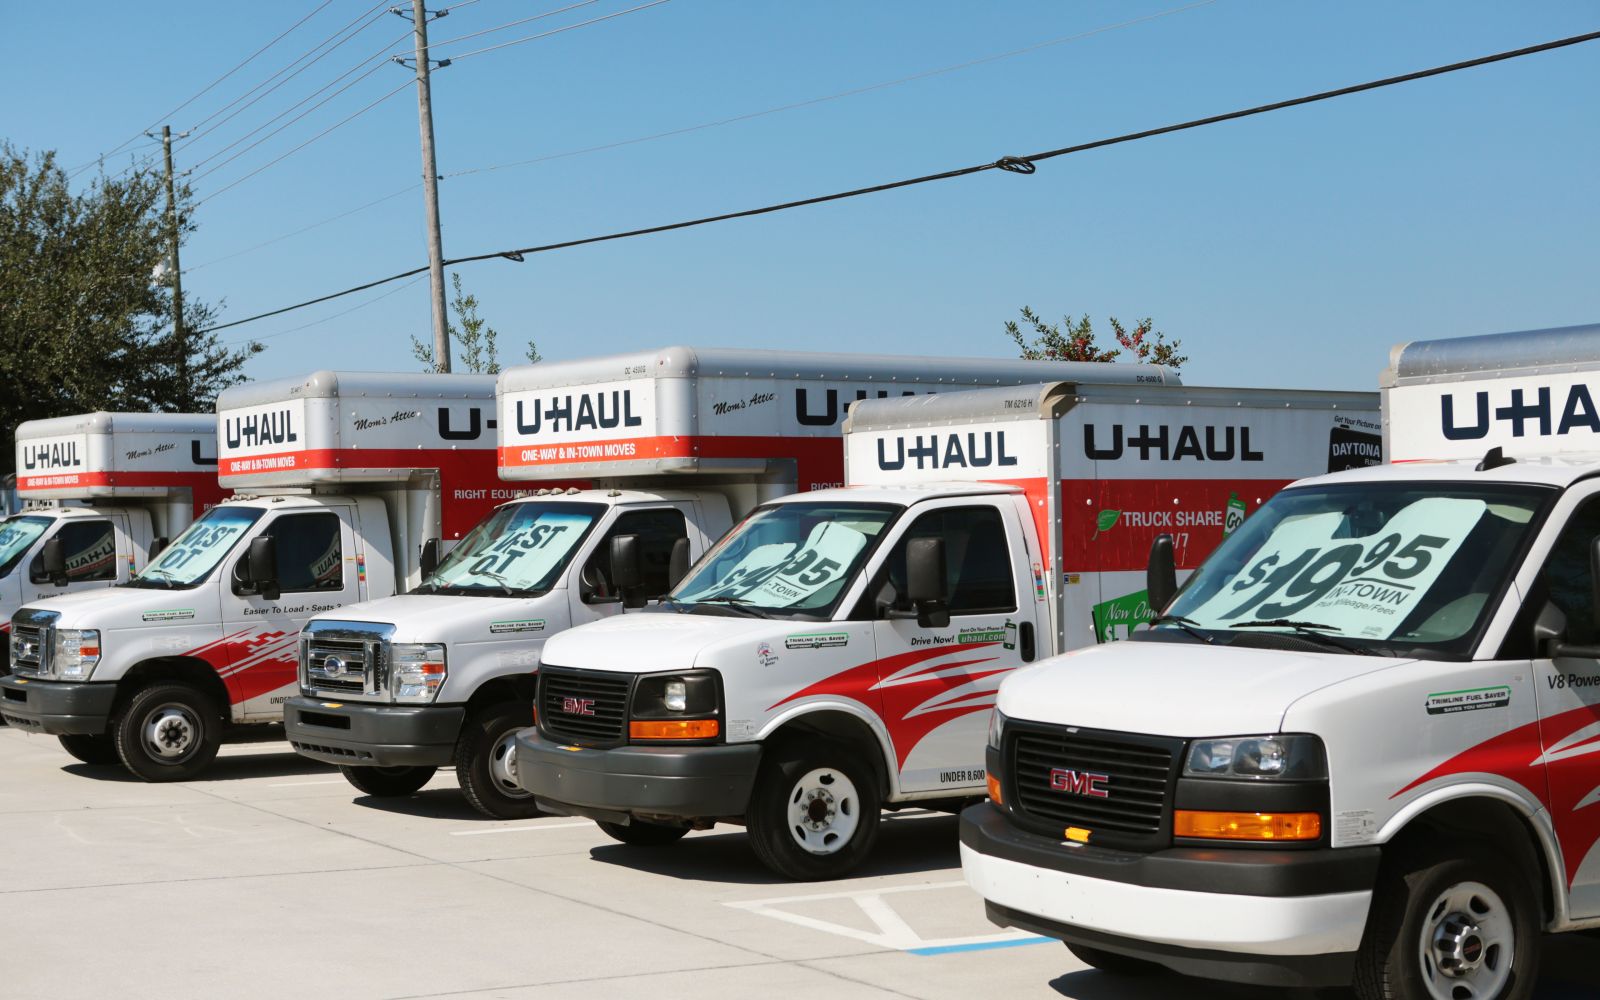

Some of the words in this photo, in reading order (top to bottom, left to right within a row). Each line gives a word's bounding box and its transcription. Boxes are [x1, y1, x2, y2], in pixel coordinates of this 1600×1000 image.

[516, 390, 642, 435] U-HAUL
[713, 400, 746, 416] Mom's
[749, 392, 775, 407] Attic
[1441, 384, 1600, 441] U-HA
[226, 410, 297, 449] U-HAUL
[354, 416, 387, 431] Mom's
[390, 411, 417, 424] Attic
[877, 431, 1018, 471] U-HAUL
[1084, 424, 1264, 461] U-HAUL
[1332, 442, 1381, 457] DAYTONA
[25, 441, 81, 470] U-HAUL
[126, 449, 152, 460] Mom's
[521, 448, 557, 461] ONE-WAY
[559, 447, 565, 459] &
[566, 445, 603, 458] IN-TOWN
[605, 443, 635, 457] MOVES
[277, 456, 295, 467] MOVES
[454, 489, 486, 499] RIGHT
[1123, 511, 1172, 527] TRUCK
[1176, 511, 1224, 526] SHARE
[1325, 584, 1410, 605] IN-TOWN
[243, 607, 269, 616] Easier
[272, 606, 281, 614] To
[284, 605, 304, 613] Load
[312, 604, 335, 612] Seats
[911, 637, 931, 646] Drive
[933, 635, 955, 644] Now!
[1548, 674, 1565, 689] V8
[1568, 673, 1600, 688] Powe
[563, 698, 595, 716] GMC
[1432, 696, 1464, 705] TRIMLINE
[940, 770, 966, 783] UNDER
[967, 769, 985, 781] 8,600
[1050, 768, 1109, 798] GMC
